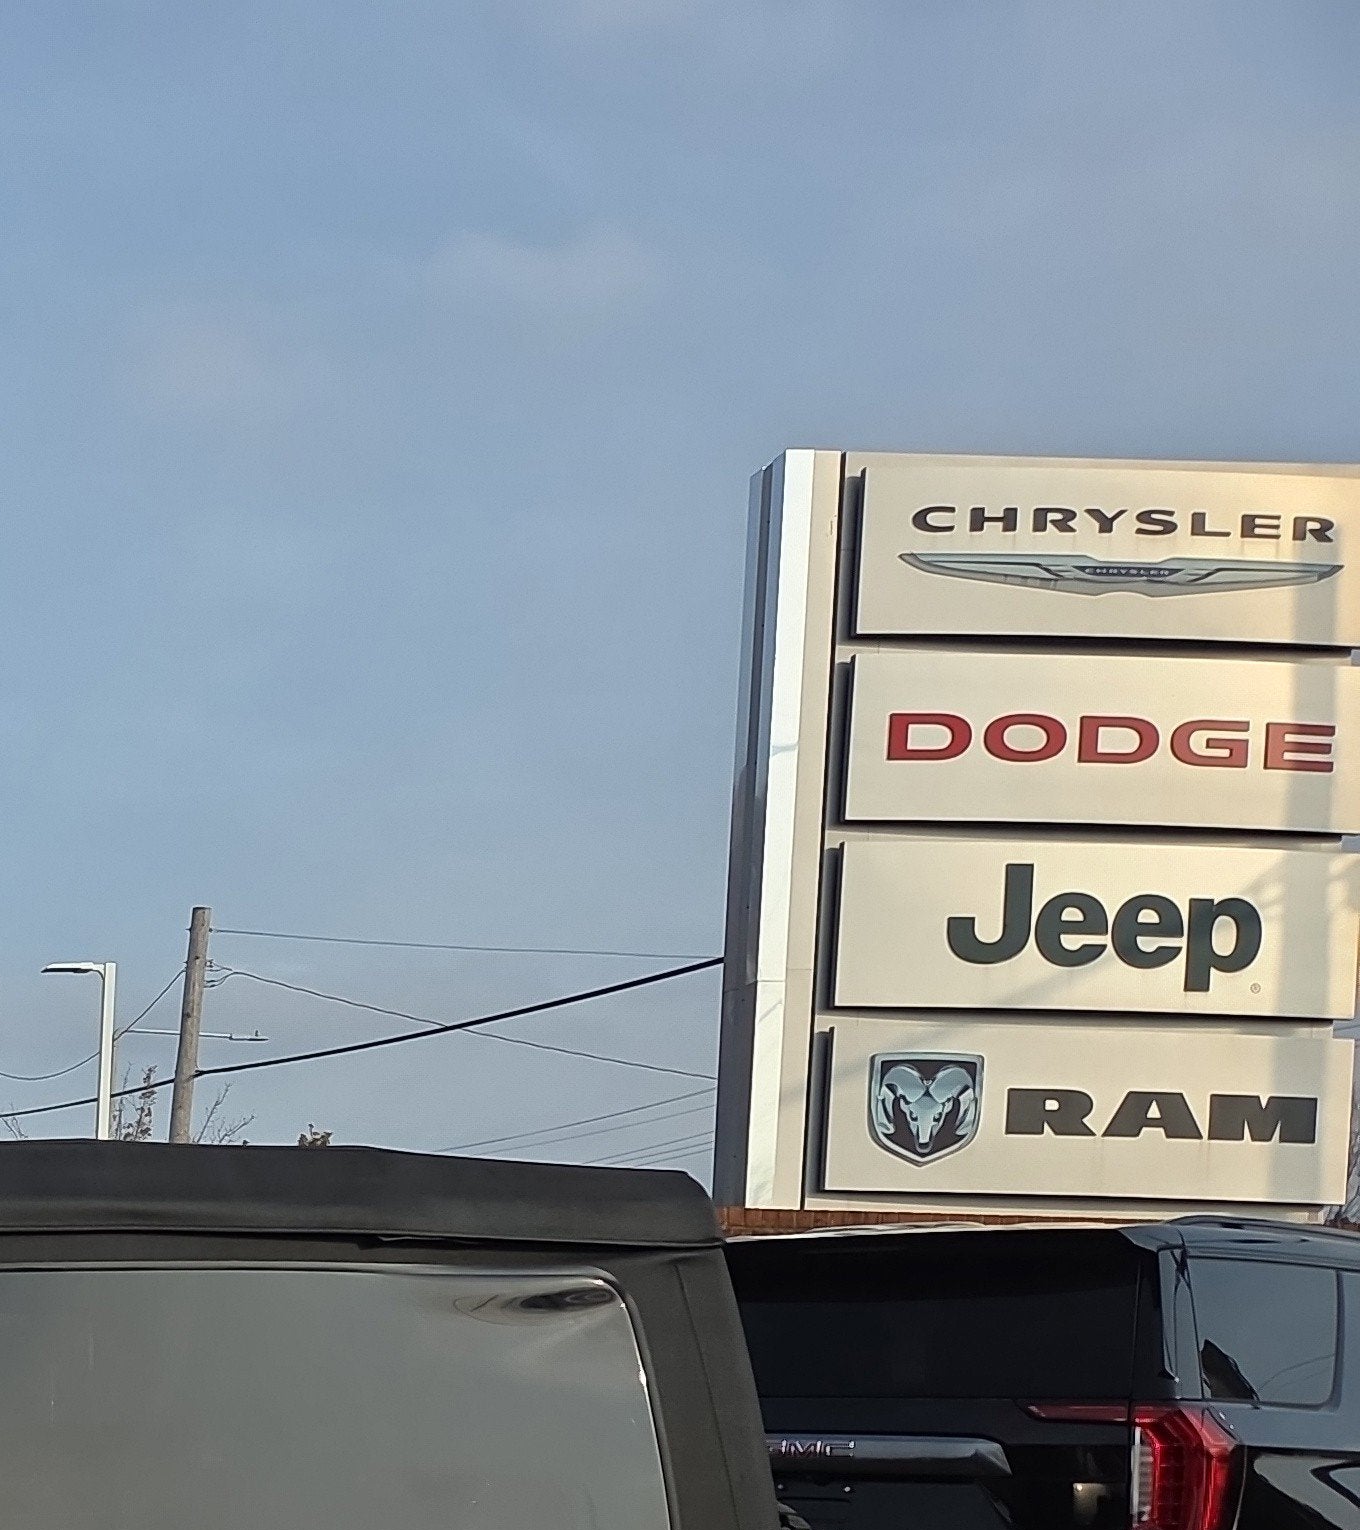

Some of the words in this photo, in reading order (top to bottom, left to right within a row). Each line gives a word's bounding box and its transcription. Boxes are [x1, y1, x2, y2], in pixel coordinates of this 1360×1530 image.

[911, 505, 1336, 543] CHRYSLER
[886, 712, 1336, 774] DODGE
[945, 862, 1263, 993] Jeep
[1004, 1086, 1319, 1145] RAM
